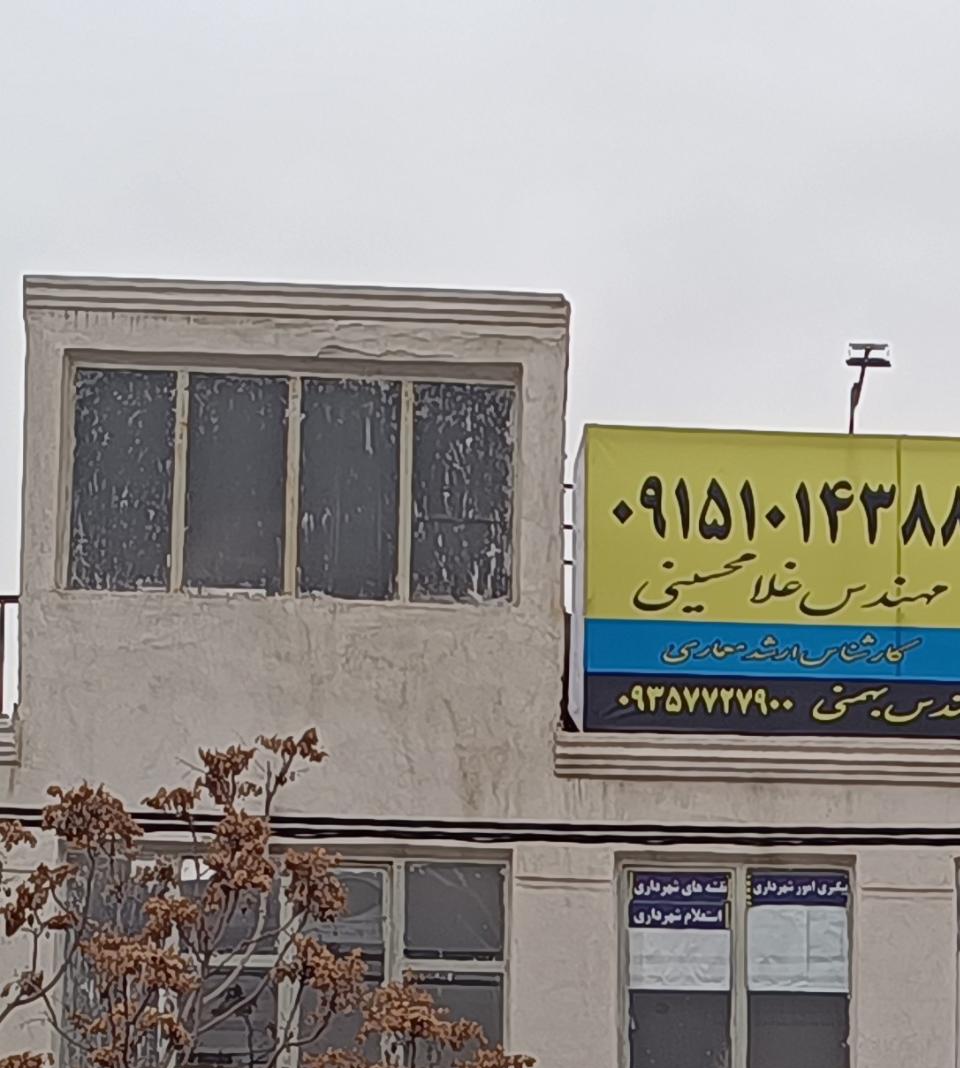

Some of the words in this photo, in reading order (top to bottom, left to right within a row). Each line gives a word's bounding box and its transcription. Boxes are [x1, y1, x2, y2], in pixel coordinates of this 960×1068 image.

[799, 577, 949, 616] مهندس
[661, 638, 748, 664] معماری
[744, 634, 801, 662] ارشد
[799, 632, 922, 667] کارشناس
[618, 685, 794, 716] ۰۹۳۵۷۷۲۷۹۰۰
[811, 684, 890, 722] بهمنی
[633, 879, 680, 897] شهرداری
[752, 880, 795, 896] شهرداری
[795, 879, 816, 896] امور
[633, 907, 682, 925] شهرداری
[683, 907, 723, 925] استعلام
